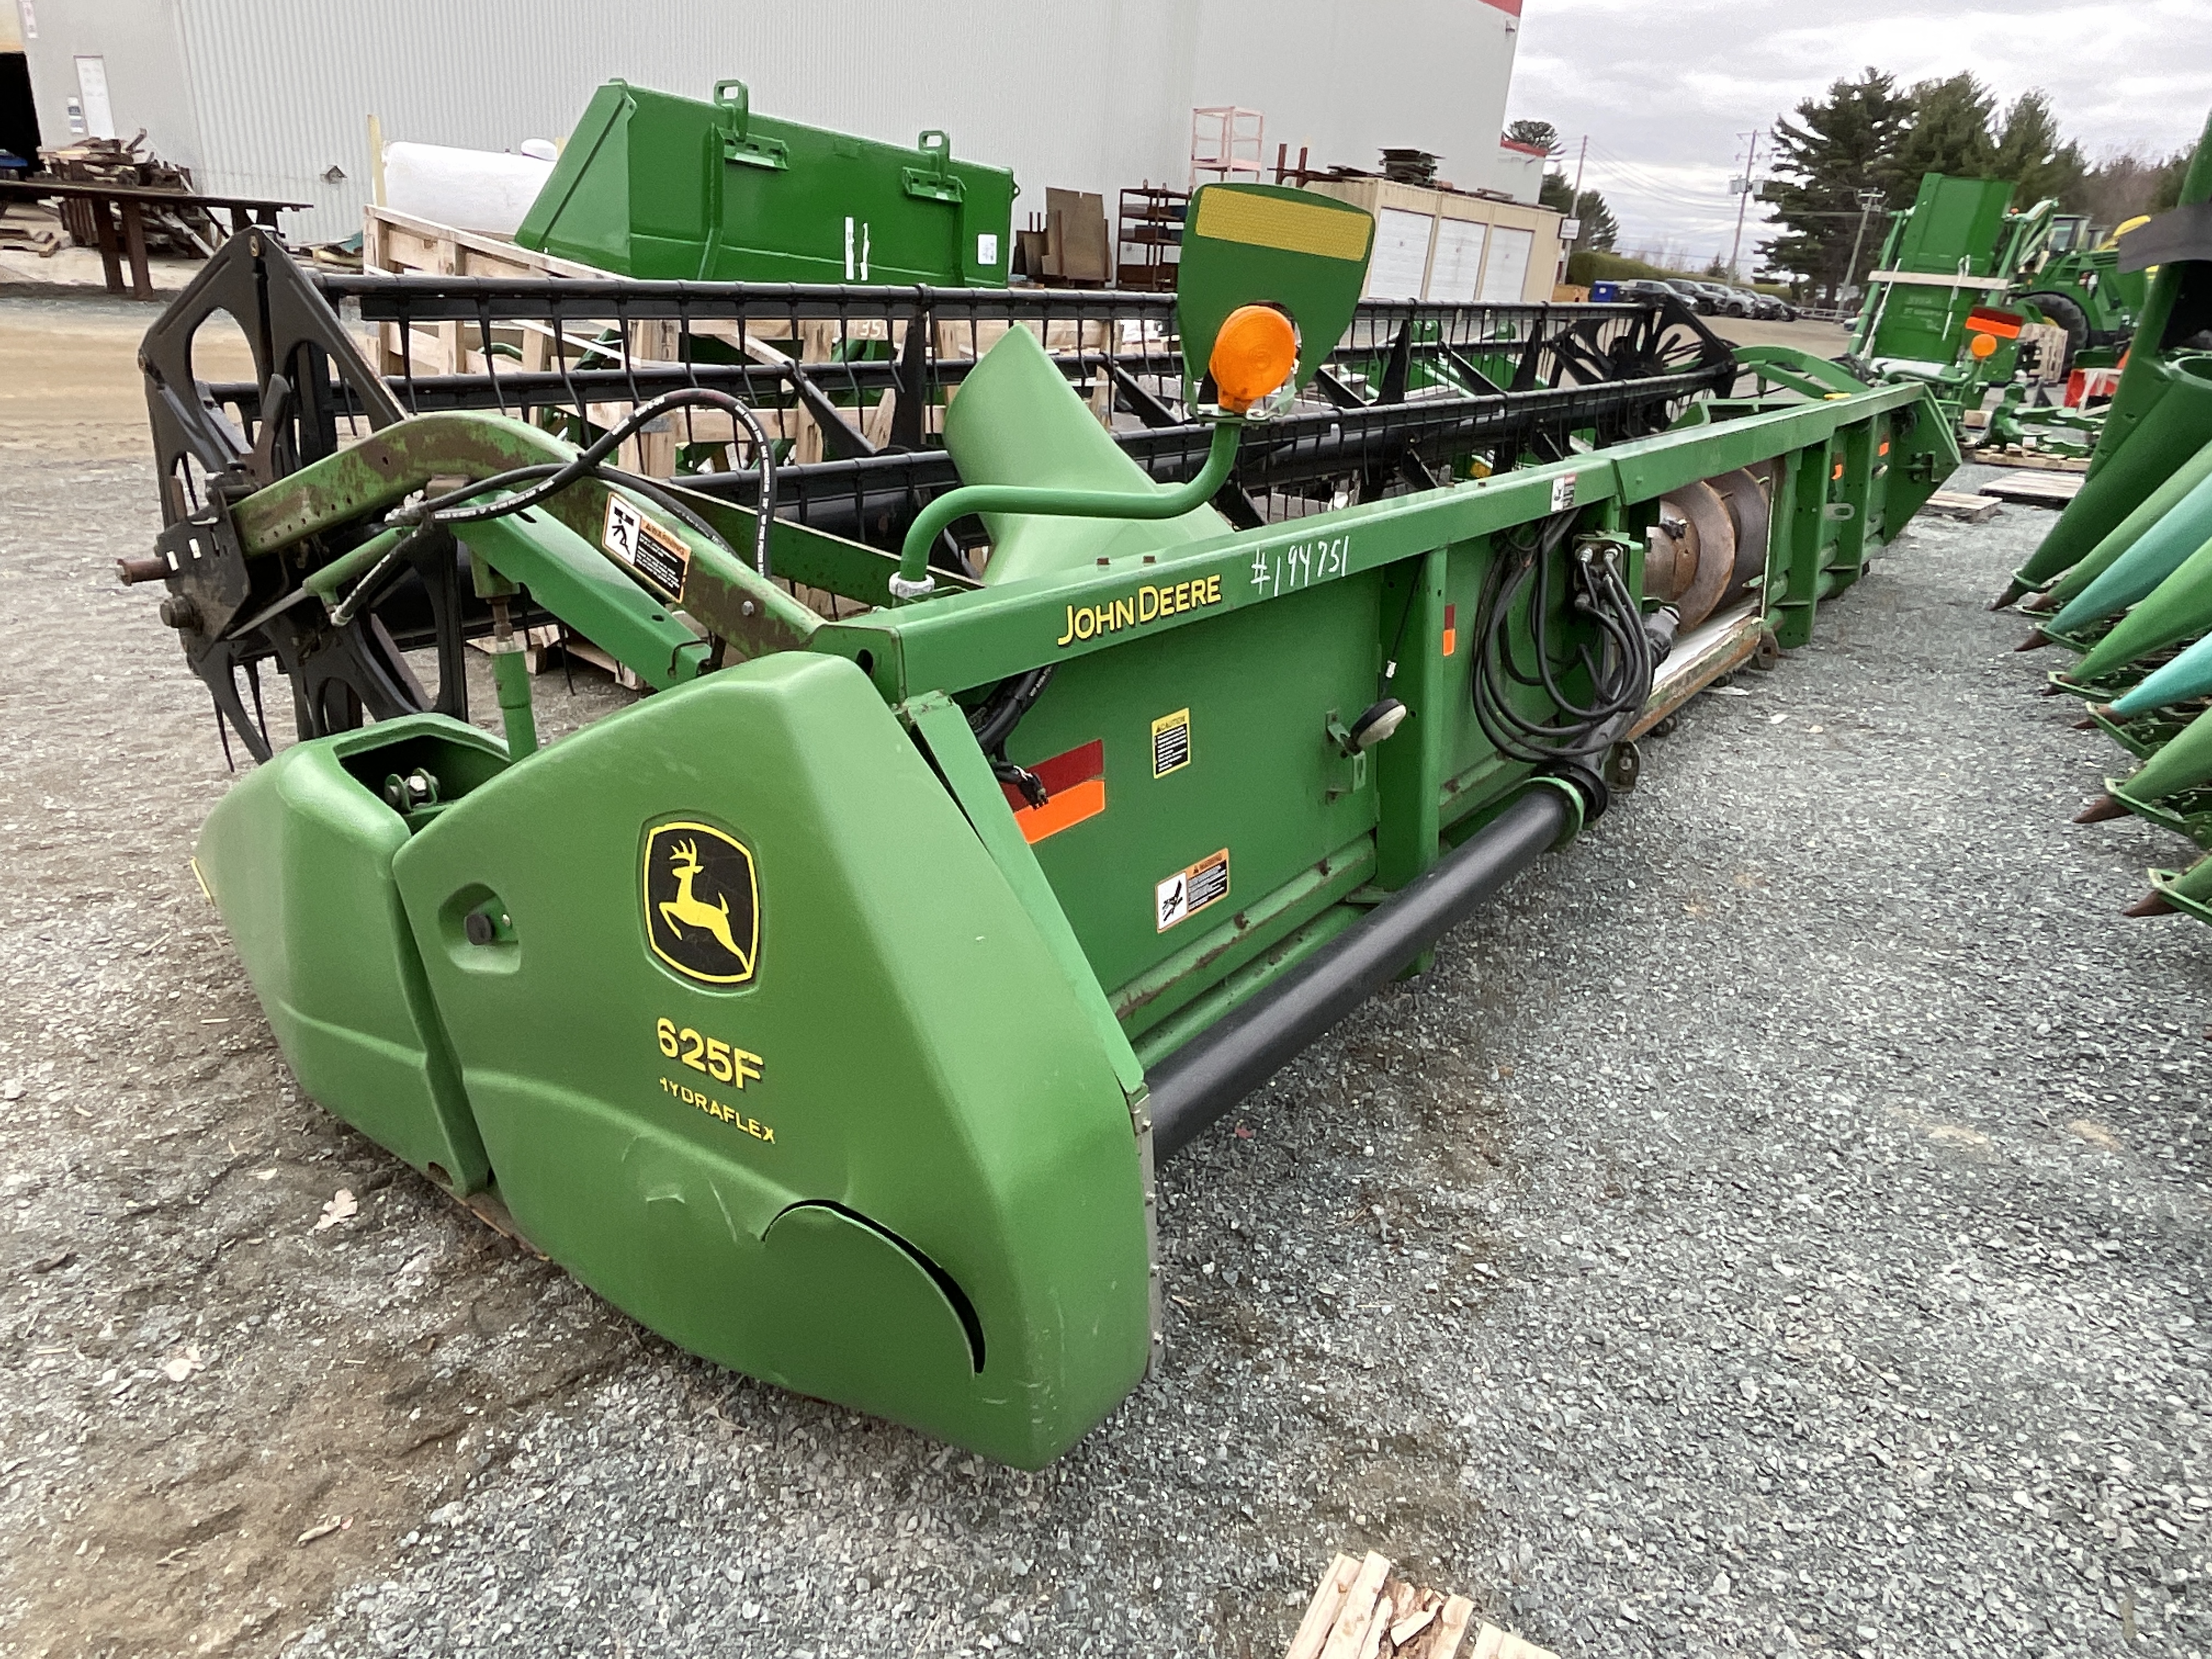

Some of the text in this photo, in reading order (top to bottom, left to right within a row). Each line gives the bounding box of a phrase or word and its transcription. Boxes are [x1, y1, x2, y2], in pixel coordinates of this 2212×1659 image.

[1250, 535, 1350, 597] #194751
[1057, 574, 1222, 646] JOHN DEERE
[657, 1017, 765, 1090] 625F
